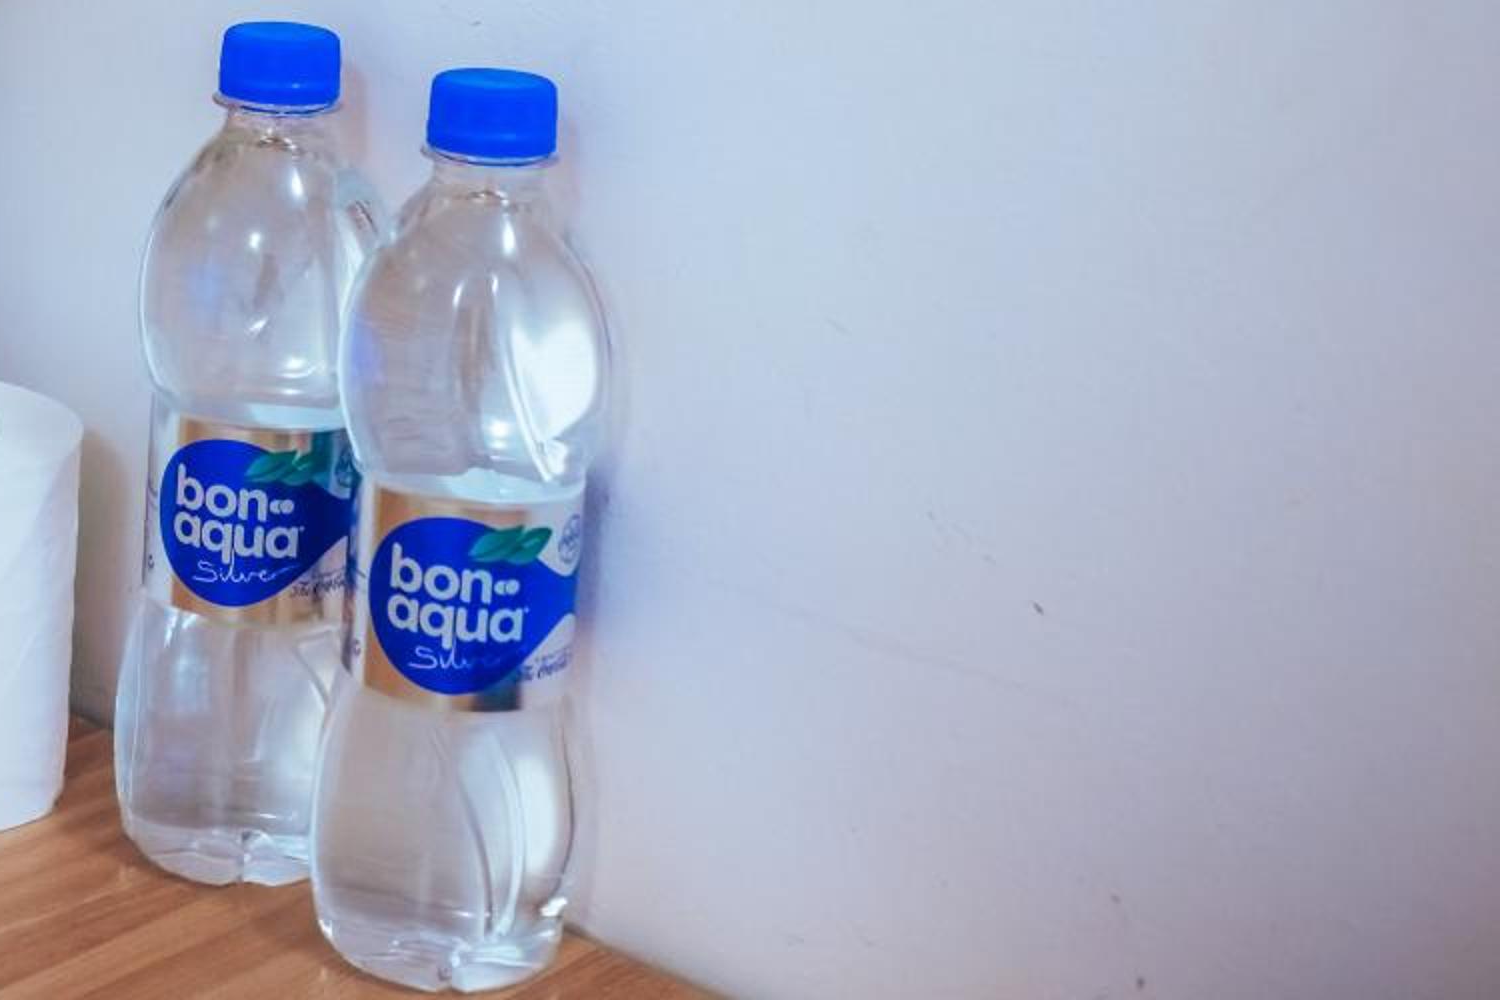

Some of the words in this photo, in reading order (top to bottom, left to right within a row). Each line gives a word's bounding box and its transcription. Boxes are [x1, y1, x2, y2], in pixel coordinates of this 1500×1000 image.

[173, 511, 300, 565] aqua
[387, 593, 524, 650] aqua
[407, 637, 480, 670] Sil
